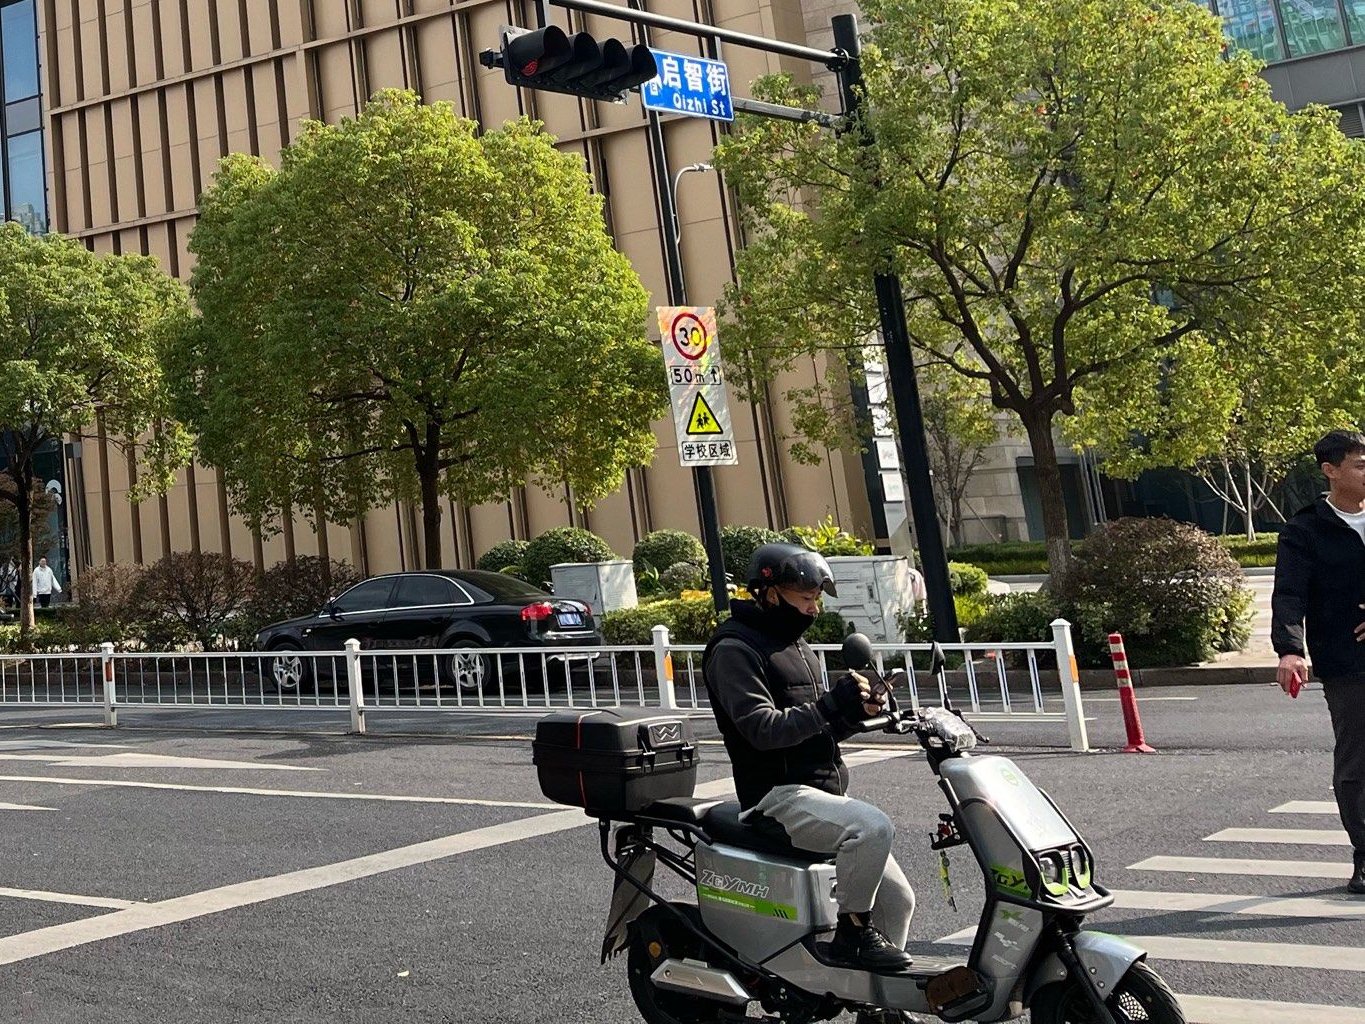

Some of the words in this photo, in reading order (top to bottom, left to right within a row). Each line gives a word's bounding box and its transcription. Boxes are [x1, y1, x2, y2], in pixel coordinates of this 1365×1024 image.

[662, 56, 727, 96] 启智街
[672, 93, 708, 114] Qizhi
[711, 101, 726, 116] St
[679, 327, 702, 346] 30
[684, 444, 732, 458] 学校区域
[699, 869, 770, 899] ZGYMH
